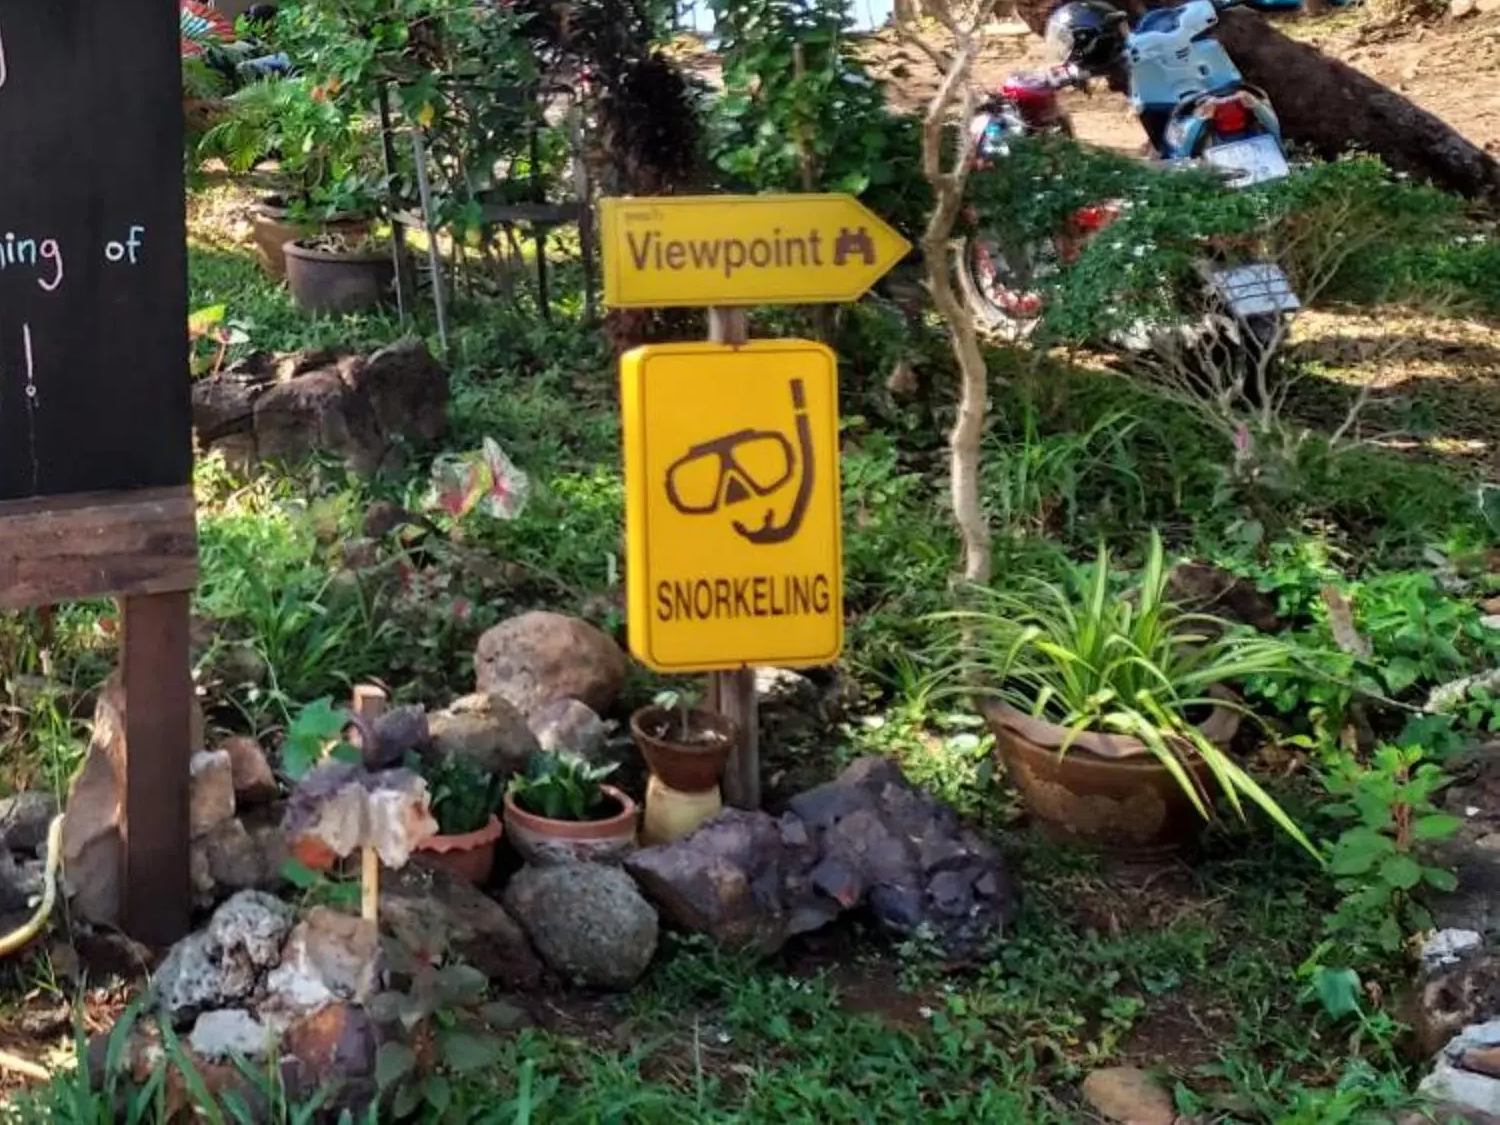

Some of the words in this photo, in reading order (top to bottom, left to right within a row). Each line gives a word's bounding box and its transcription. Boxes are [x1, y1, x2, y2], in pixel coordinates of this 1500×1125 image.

[105, 226, 144, 263] of
[626, 230, 823, 278] Viewpoint
[657, 573, 830, 622] SNORKELING
